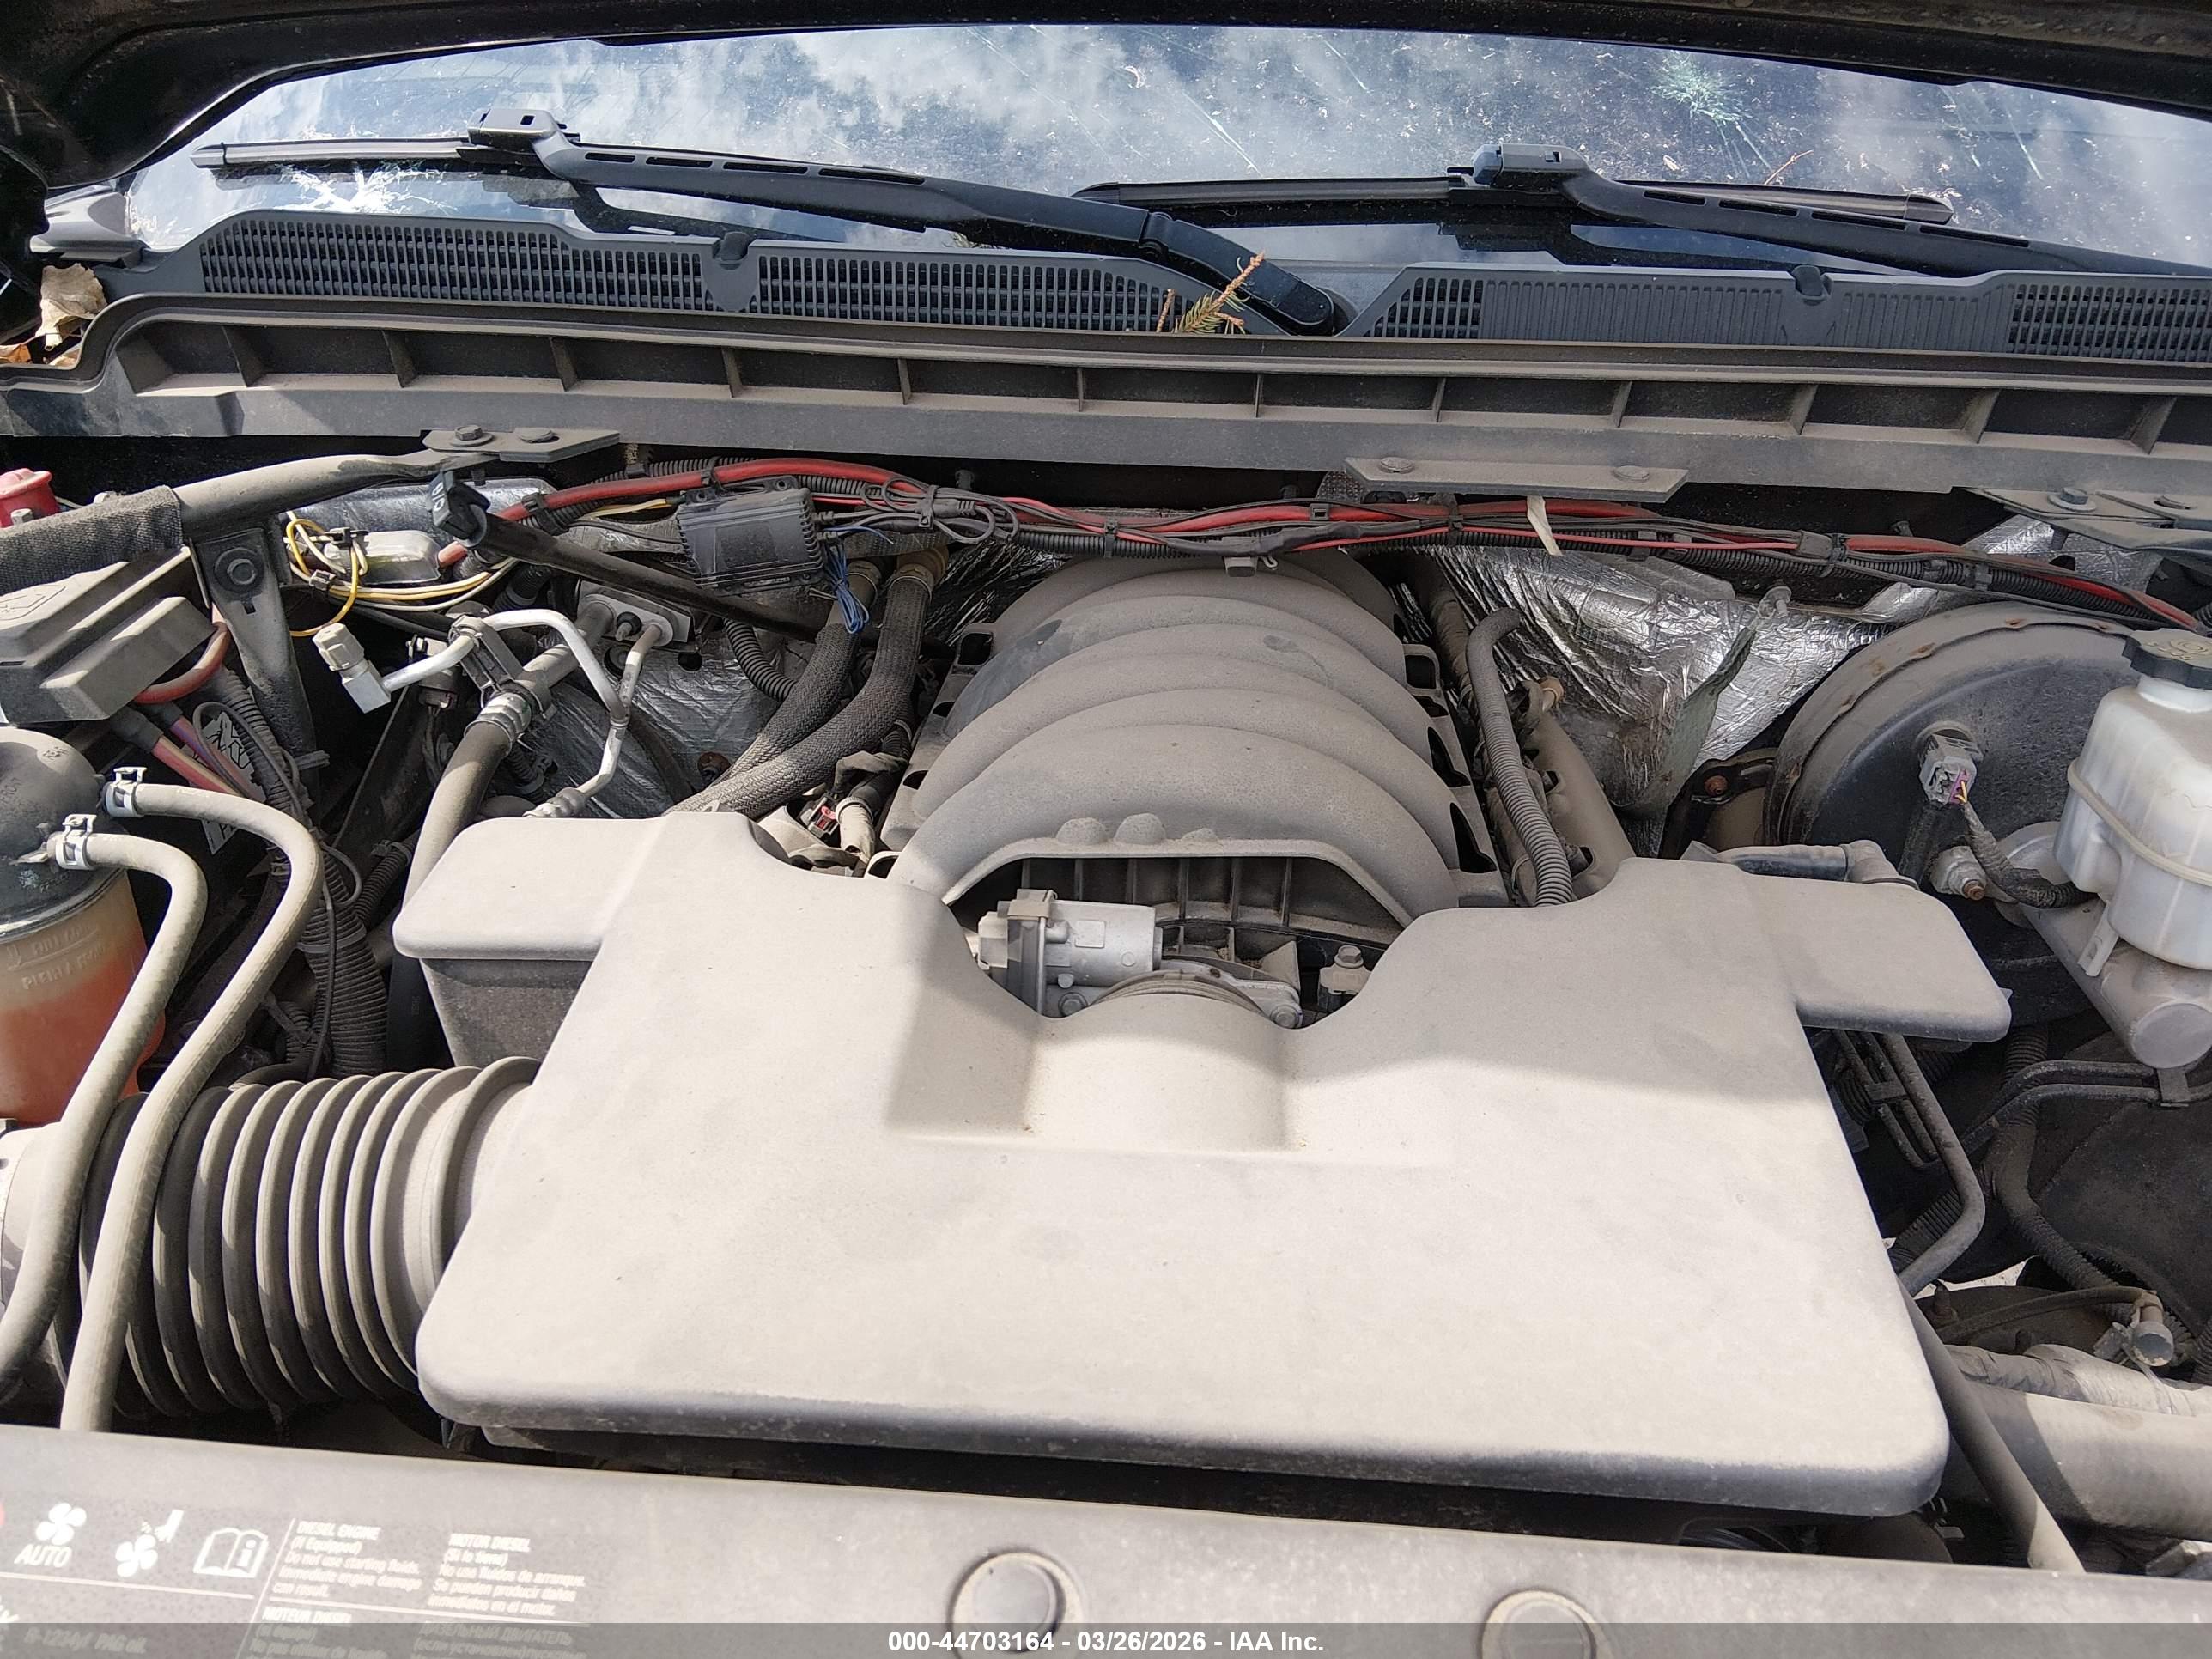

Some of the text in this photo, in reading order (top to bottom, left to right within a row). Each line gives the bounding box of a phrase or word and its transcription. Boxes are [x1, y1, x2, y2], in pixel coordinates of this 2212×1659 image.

[297, 1522, 380, 1540] DIESEL ENGINE
[306, 1538, 362, 1555] Equipped)
[449, 1534, 530, 1552] MOTOR DIESEL
[15, 1545, 71, 1567] AUTO
[285, 1552, 300, 1565] Do
[302, 1554, 320, 1565] not
[322, 1557, 343, 1567] use
[344, 1558, 386, 1573] starting
[279, 1566, 422, 1591] Immediate engine damage
[440, 1565, 455, 1576] No
[457, 1567, 477, 1578] use
[518, 1571, 532, 1582] de
[272, 1583, 294, 1594] can
[433, 1578, 448, 1591] Se
[450, 1582, 492, 1595] pueden
[494, 1584, 540, 1598] producir
[262, 1607, 312, 1622] MOTEUR
[95, 1634, 126, 1651] PAG
